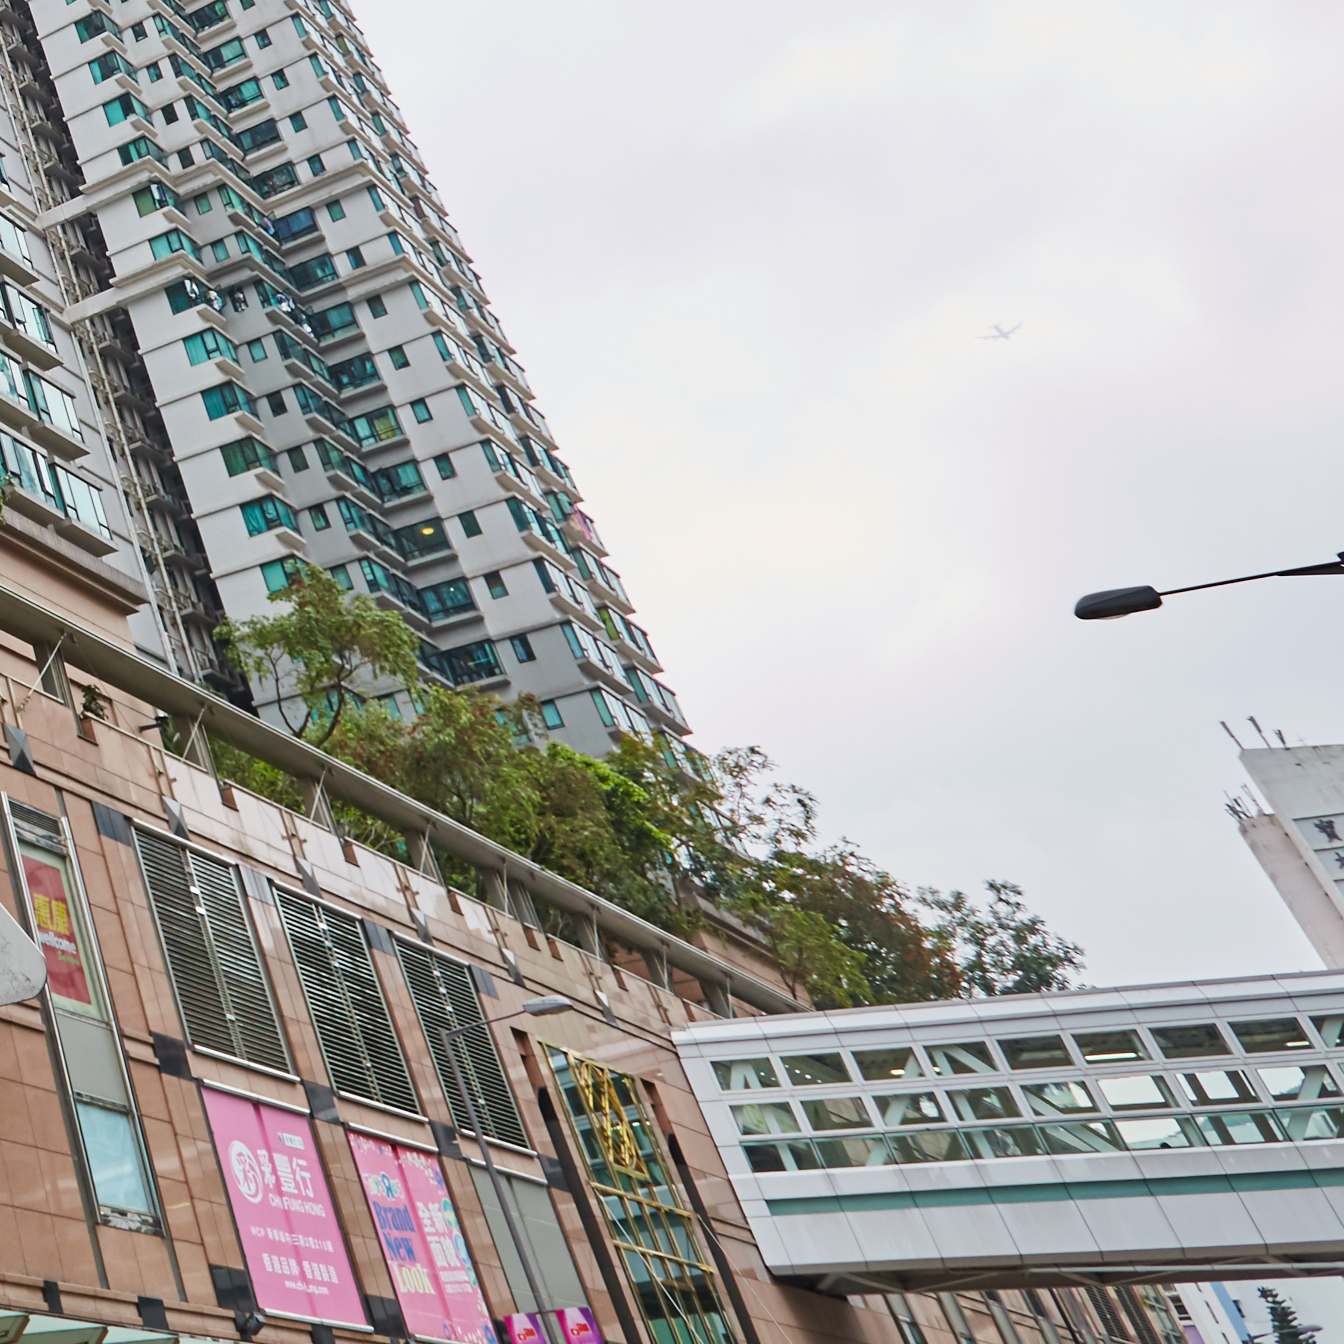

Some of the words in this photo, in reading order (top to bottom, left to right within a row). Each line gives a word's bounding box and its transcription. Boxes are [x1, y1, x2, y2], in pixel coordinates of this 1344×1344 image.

[33, 893, 69, 936] 惠康
[372, 1201, 415, 1232] Brand
[416, 1201, 448, 1234] 全新
[383, 1231, 417, 1263] New
[393, 1262, 435, 1295] Look
